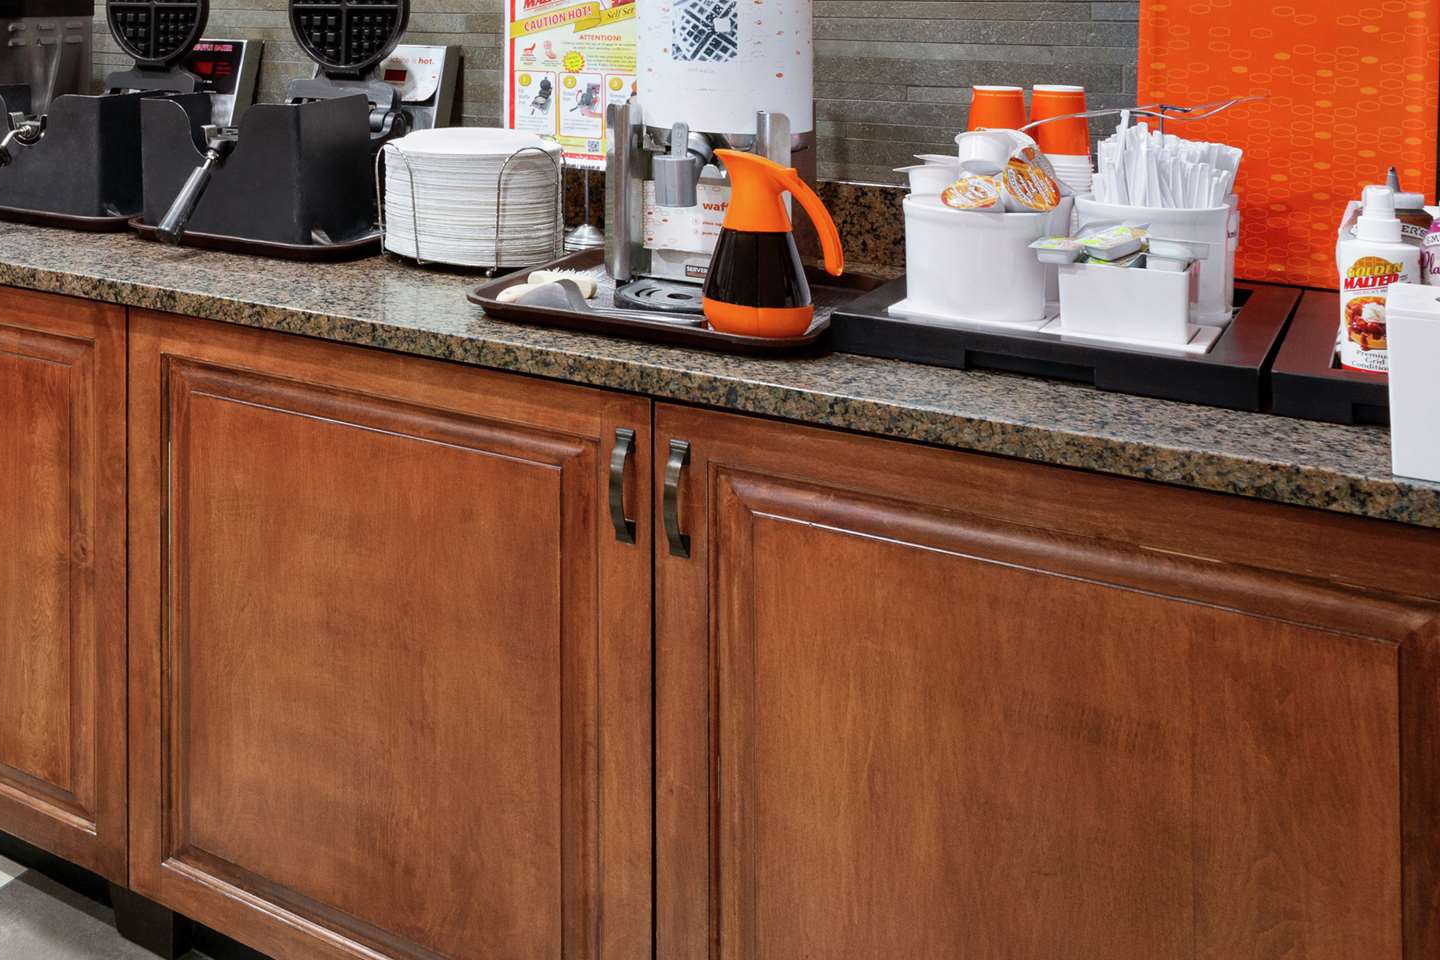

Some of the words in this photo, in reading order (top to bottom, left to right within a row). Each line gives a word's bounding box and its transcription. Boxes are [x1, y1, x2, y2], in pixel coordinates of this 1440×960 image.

[524, 13, 566, 31] CAUTION
[568, 5, 592, 20] HOT!
[1344, 273, 1399, 289] MALTED
